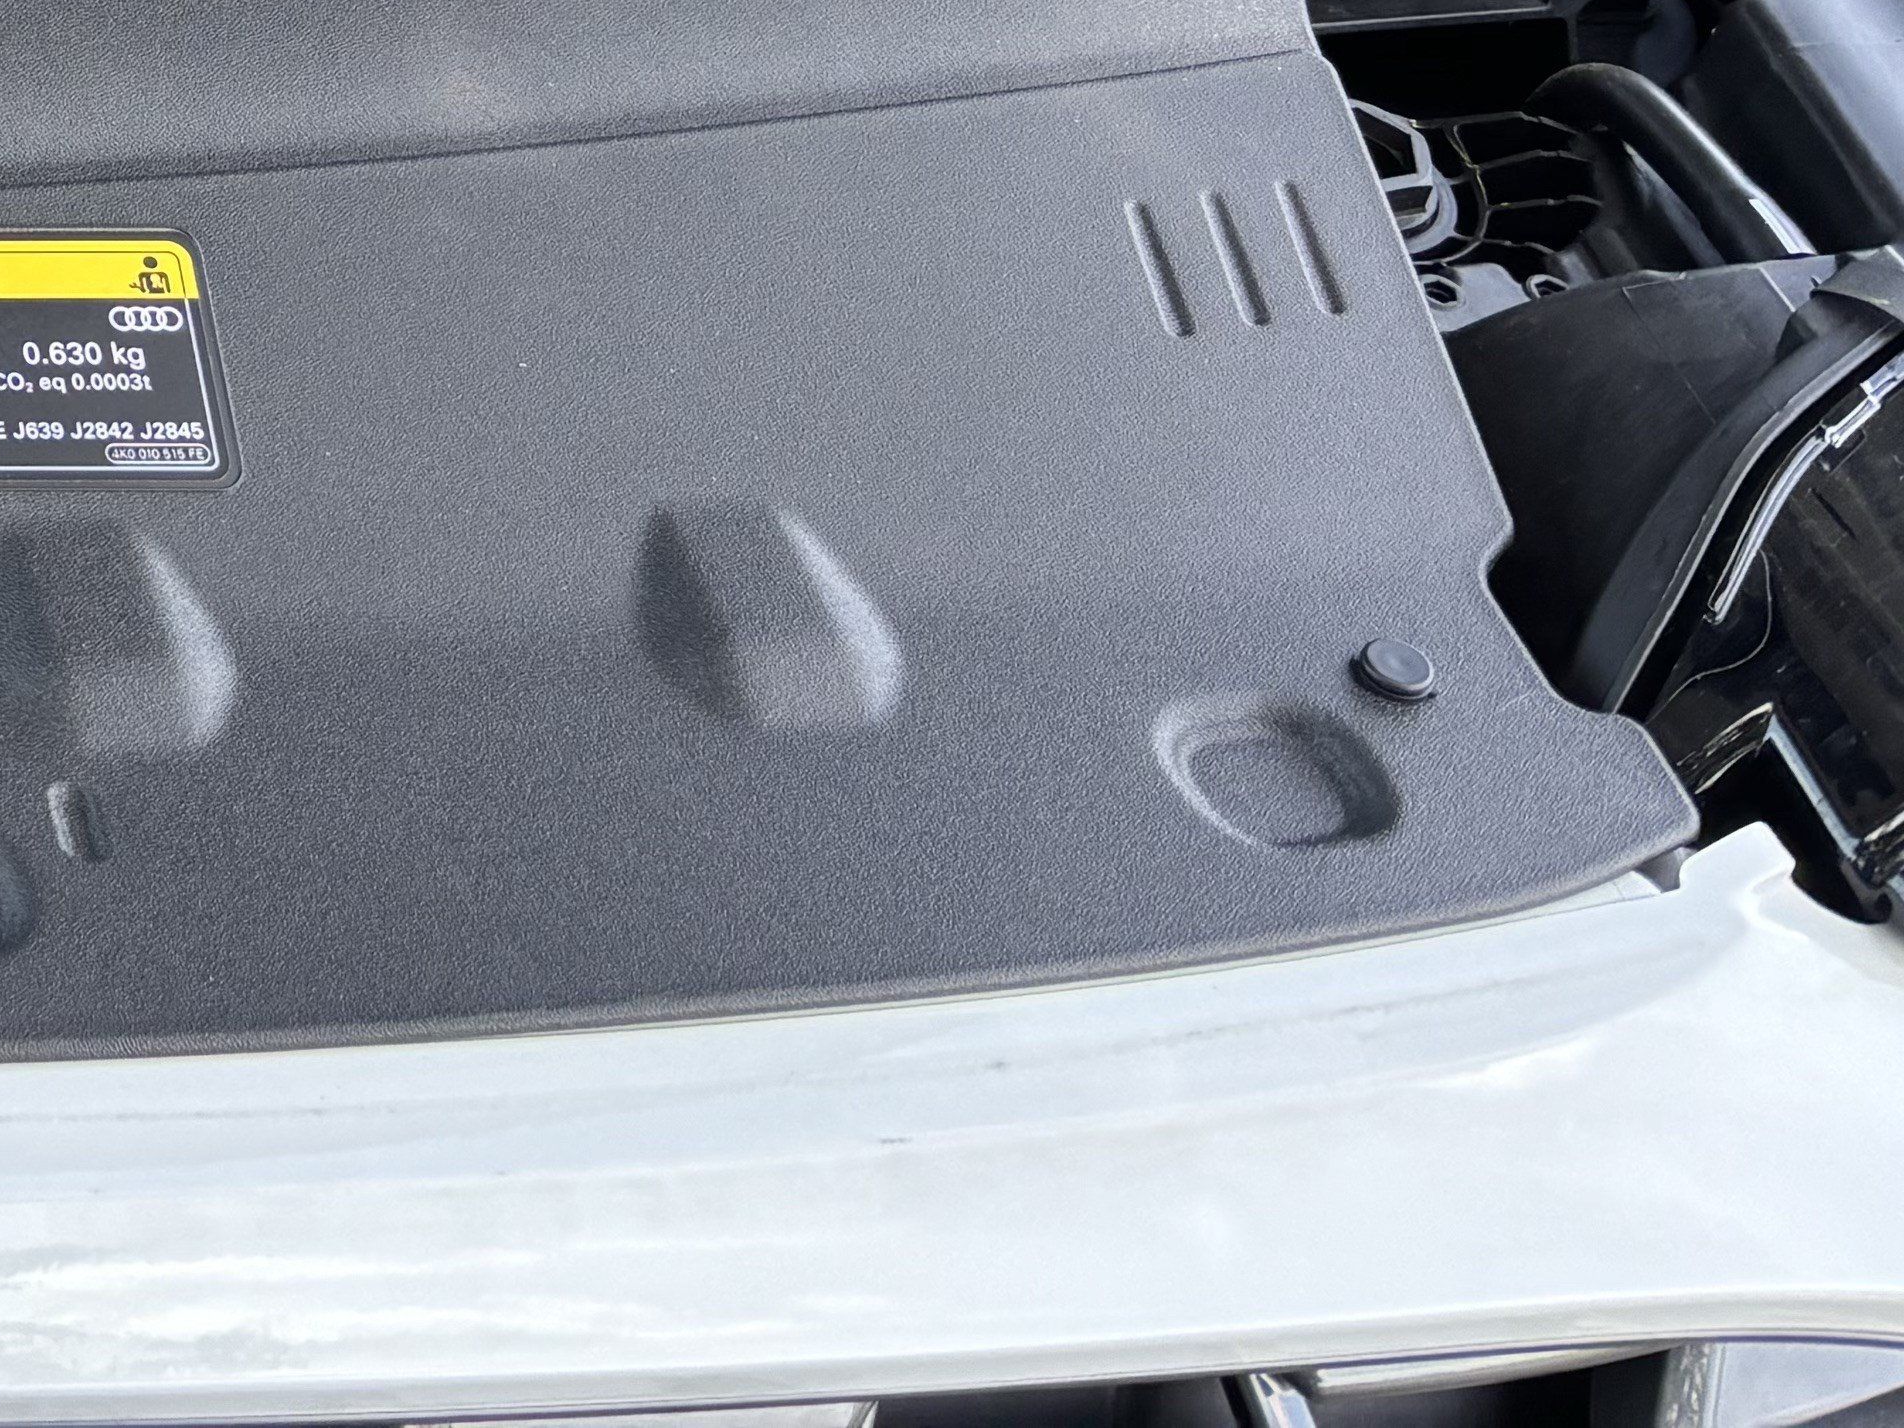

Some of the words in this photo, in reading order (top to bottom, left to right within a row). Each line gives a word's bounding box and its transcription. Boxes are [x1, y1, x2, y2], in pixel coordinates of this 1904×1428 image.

[22, 342, 102, 365] 0.630
[110, 342, 146, 370] kg
[39, 376, 67, 396] eq
[71, 373, 152, 392] 0.0003t
[12, 421, 64, 439] J639
[70, 421, 133, 439] J2842
[139, 421, 204, 439] J2845
